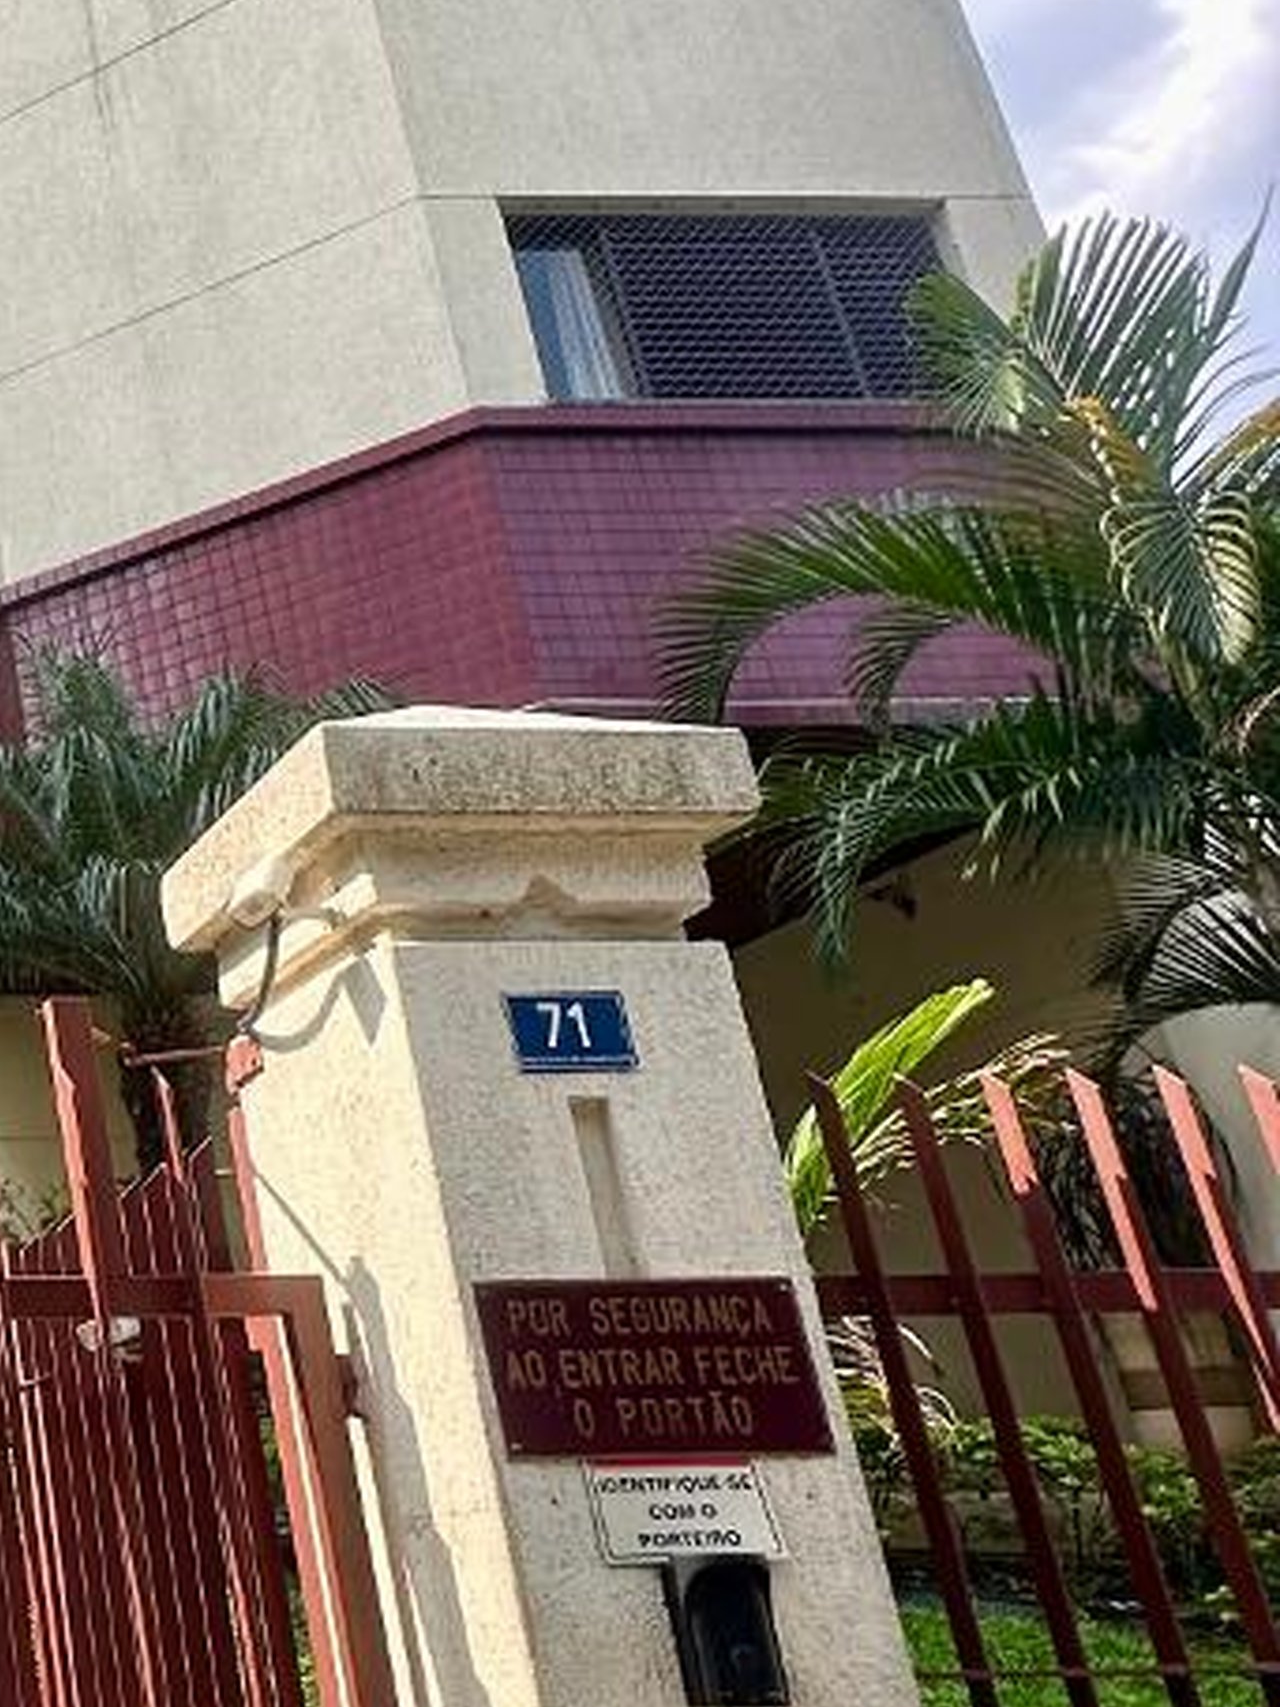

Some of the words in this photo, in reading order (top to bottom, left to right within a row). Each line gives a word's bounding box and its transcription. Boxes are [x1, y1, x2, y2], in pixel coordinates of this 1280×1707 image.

[536, 1001, 591, 1049] 71
[506, 1299, 571, 1335] POR
[589, 1296, 772, 1339] SEGURANÇA
[505, 1349, 546, 1388] AO
[559, 1346, 685, 1388] ENTRAR
[693, 1345, 801, 1384] FECHE
[574, 1398, 596, 1438] O
[615, 1392, 754, 1437] PORTÃO
